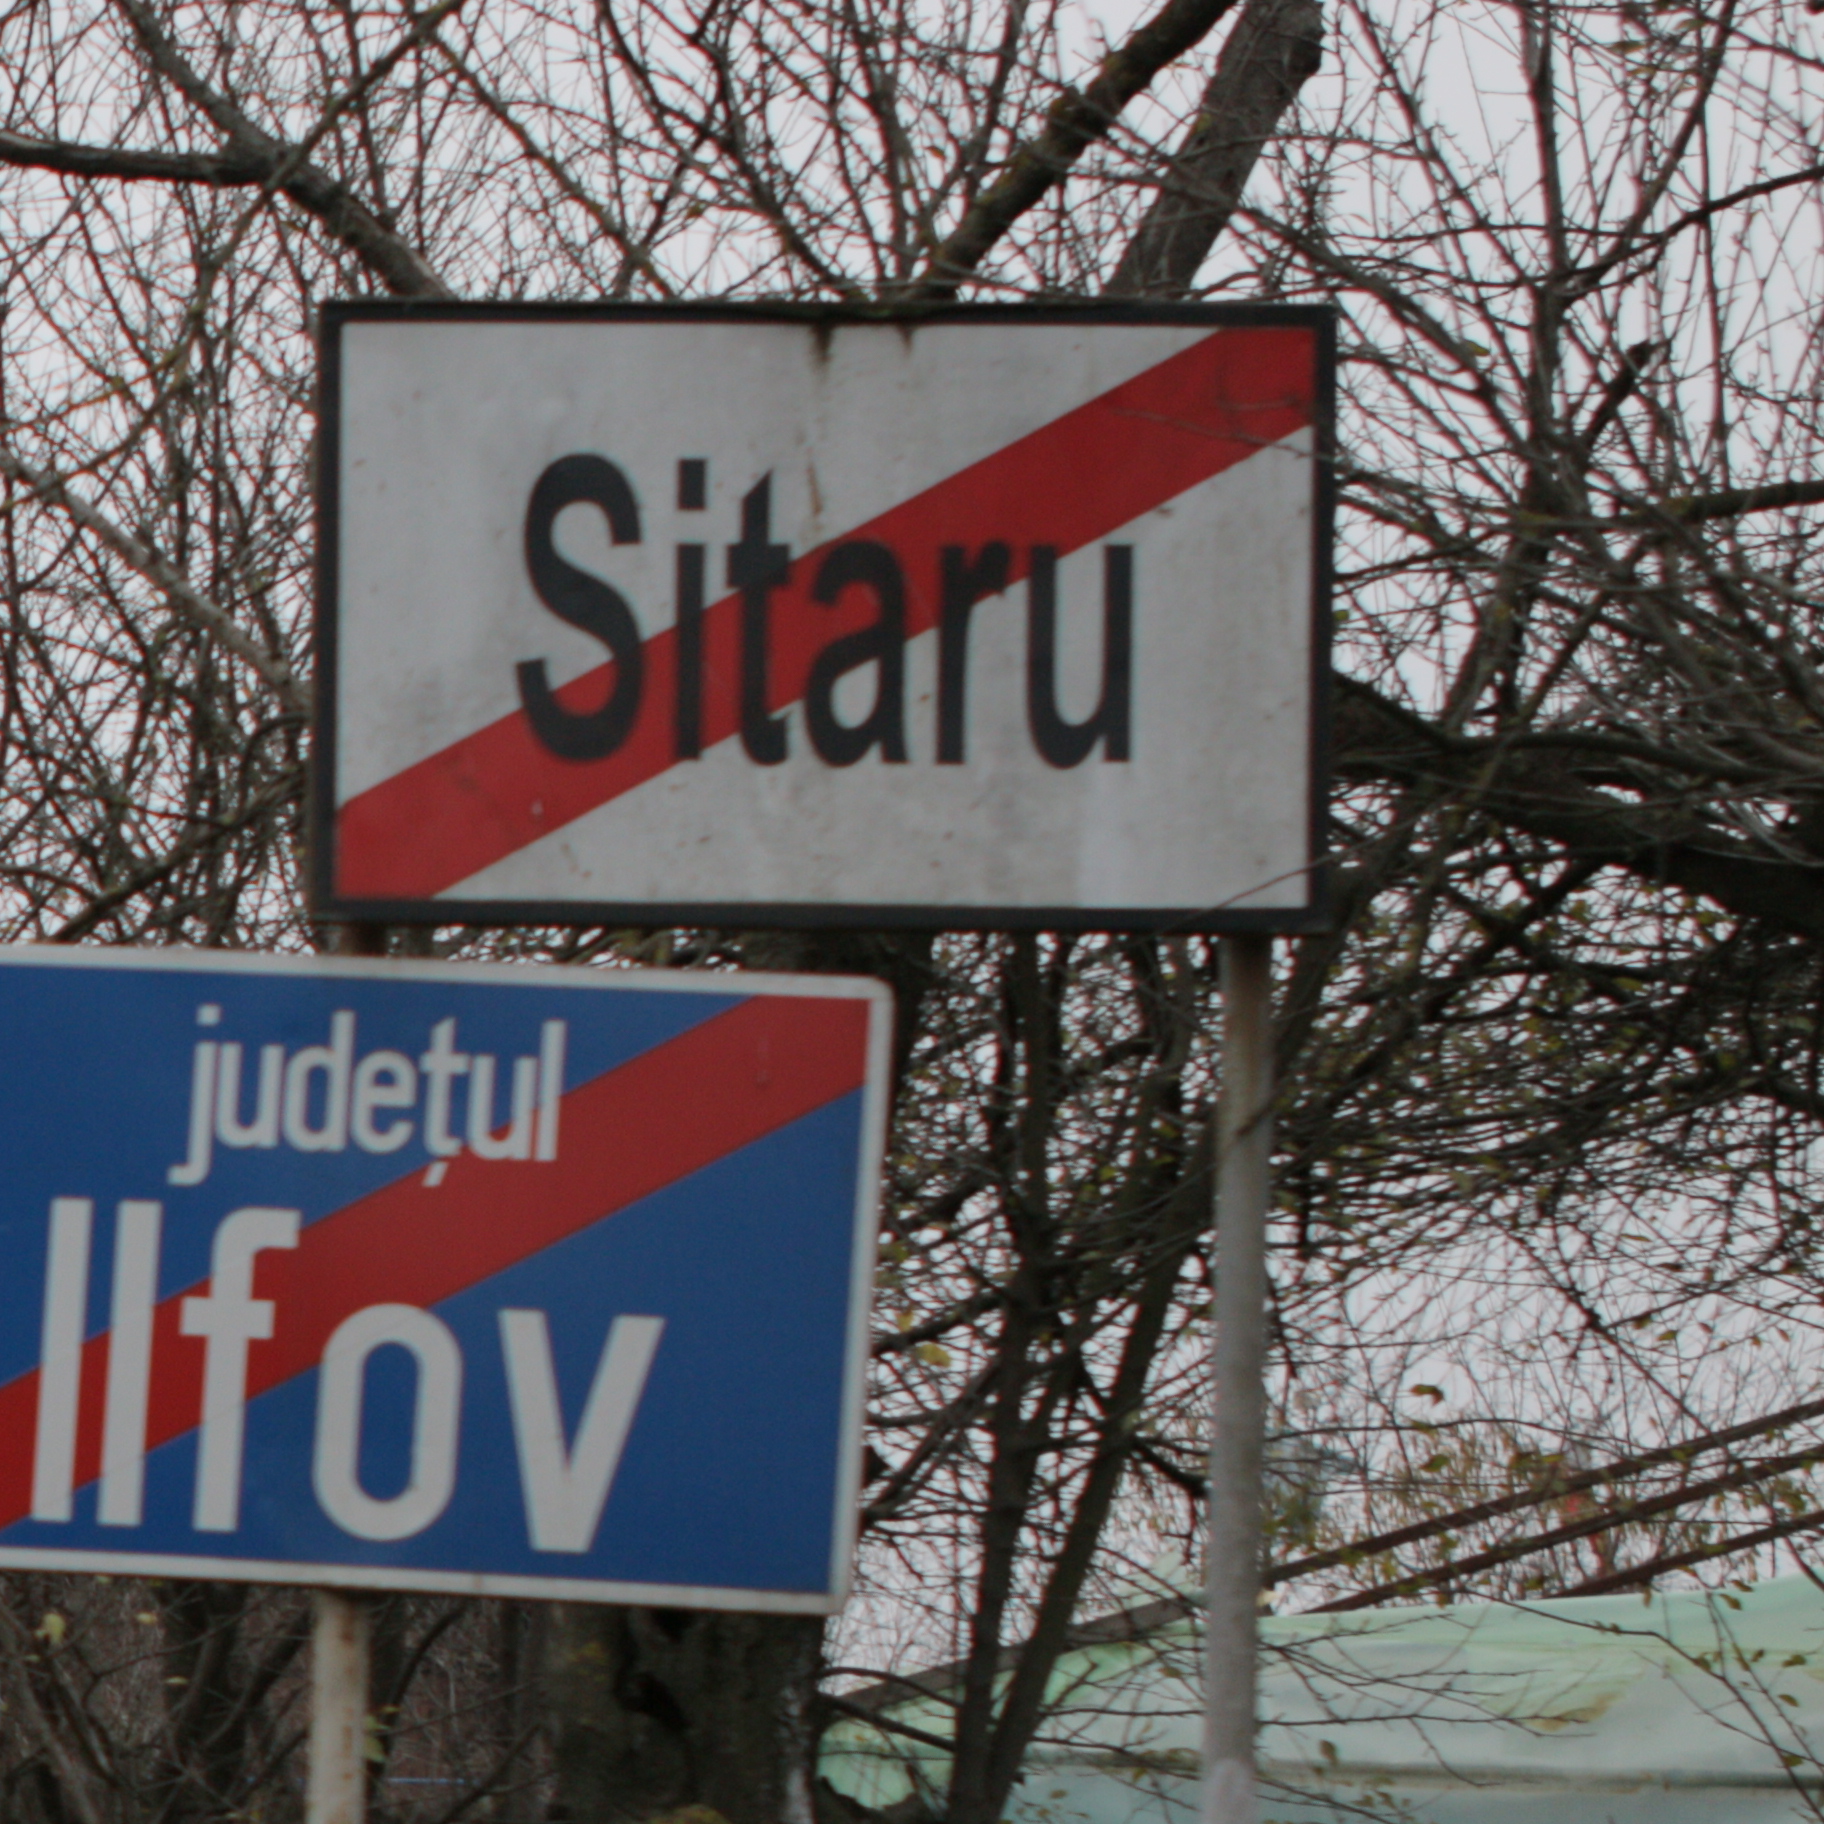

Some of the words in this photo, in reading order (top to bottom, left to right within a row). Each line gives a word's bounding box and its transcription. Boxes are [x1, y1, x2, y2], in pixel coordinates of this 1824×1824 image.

[515, 454, 1135, 768] Sitaru
[168, 1005, 567, 1188] județul
[29, 1196, 665, 1554] Ilfov
